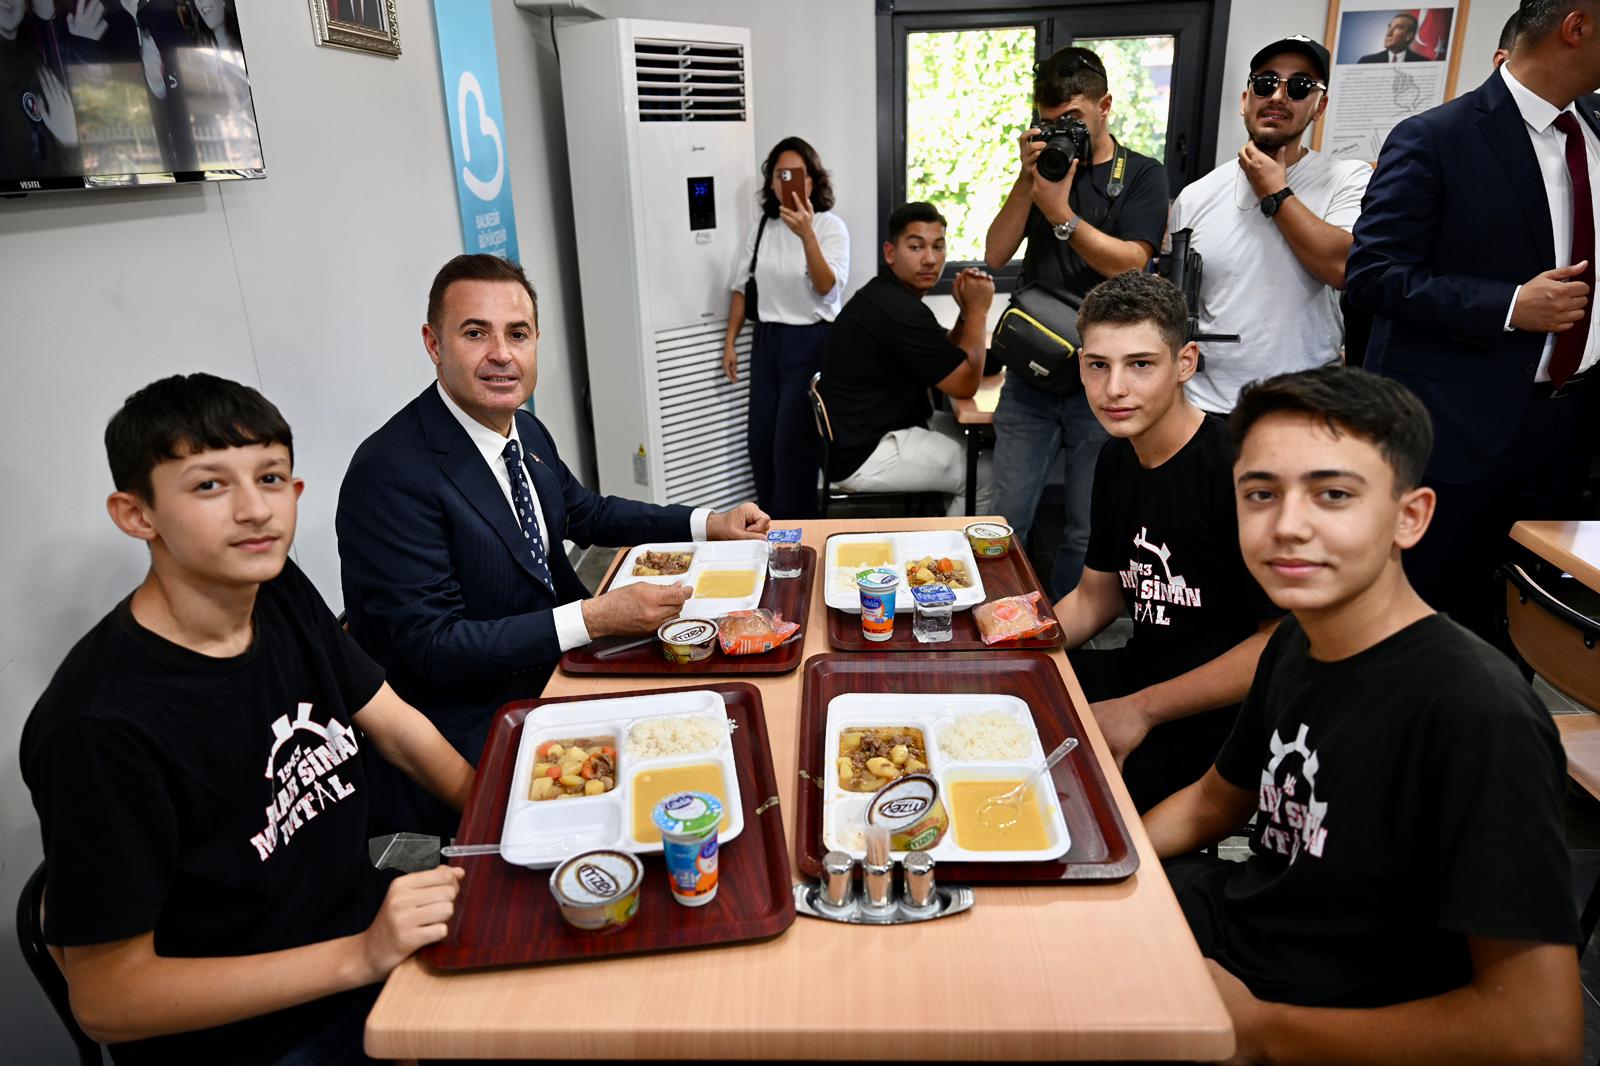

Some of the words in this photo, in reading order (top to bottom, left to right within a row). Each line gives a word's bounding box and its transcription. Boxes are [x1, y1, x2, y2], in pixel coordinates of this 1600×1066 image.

[1112, 157, 1124, 179] Nikon
[19, 181, 41, 189] VESTEL
[1141, 574, 1201, 607] SİNAN
